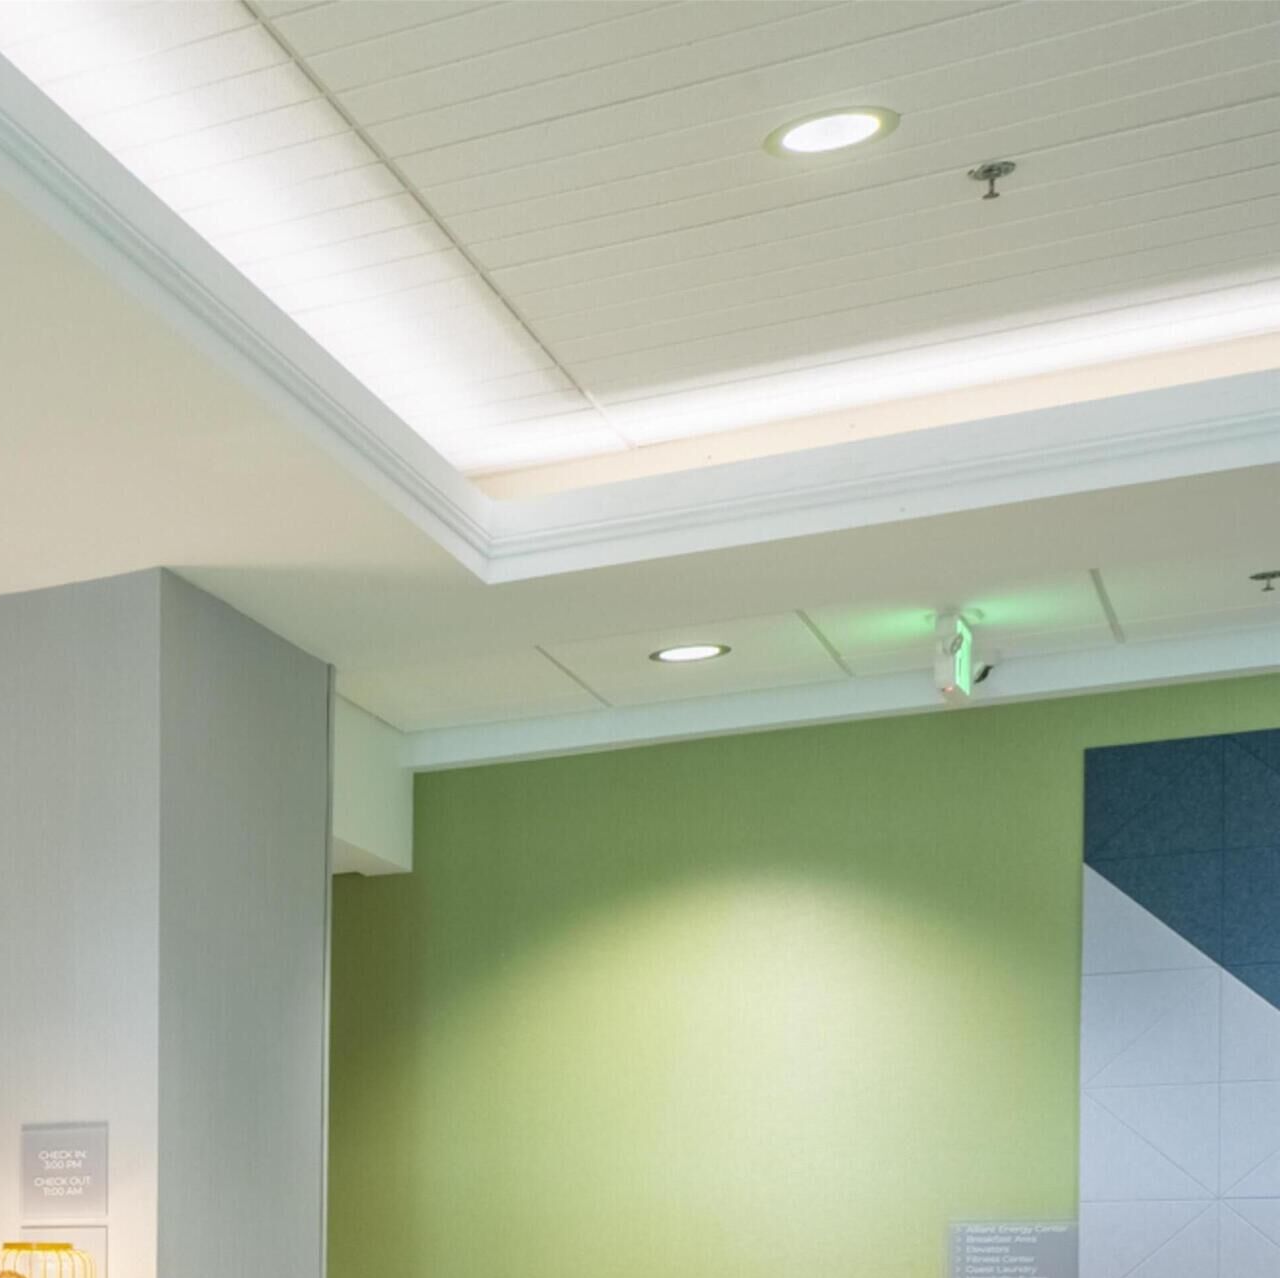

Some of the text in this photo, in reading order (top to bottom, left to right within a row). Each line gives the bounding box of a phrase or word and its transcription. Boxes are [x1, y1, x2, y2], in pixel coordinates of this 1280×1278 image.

[38, 1150, 72, 1160] CHECK
[66, 1159, 82, 1169] PM
[34, 1175, 91, 1187] CHECK OUT
[66, 1186, 83, 1196] AM
[1035, 1224, 1067, 1232] Center
[966, 1245, 1010, 1254] Elevators
[966, 1255, 1034, 1264] Fitness Center
[997, 1265, 1037, 1275] Laundry
